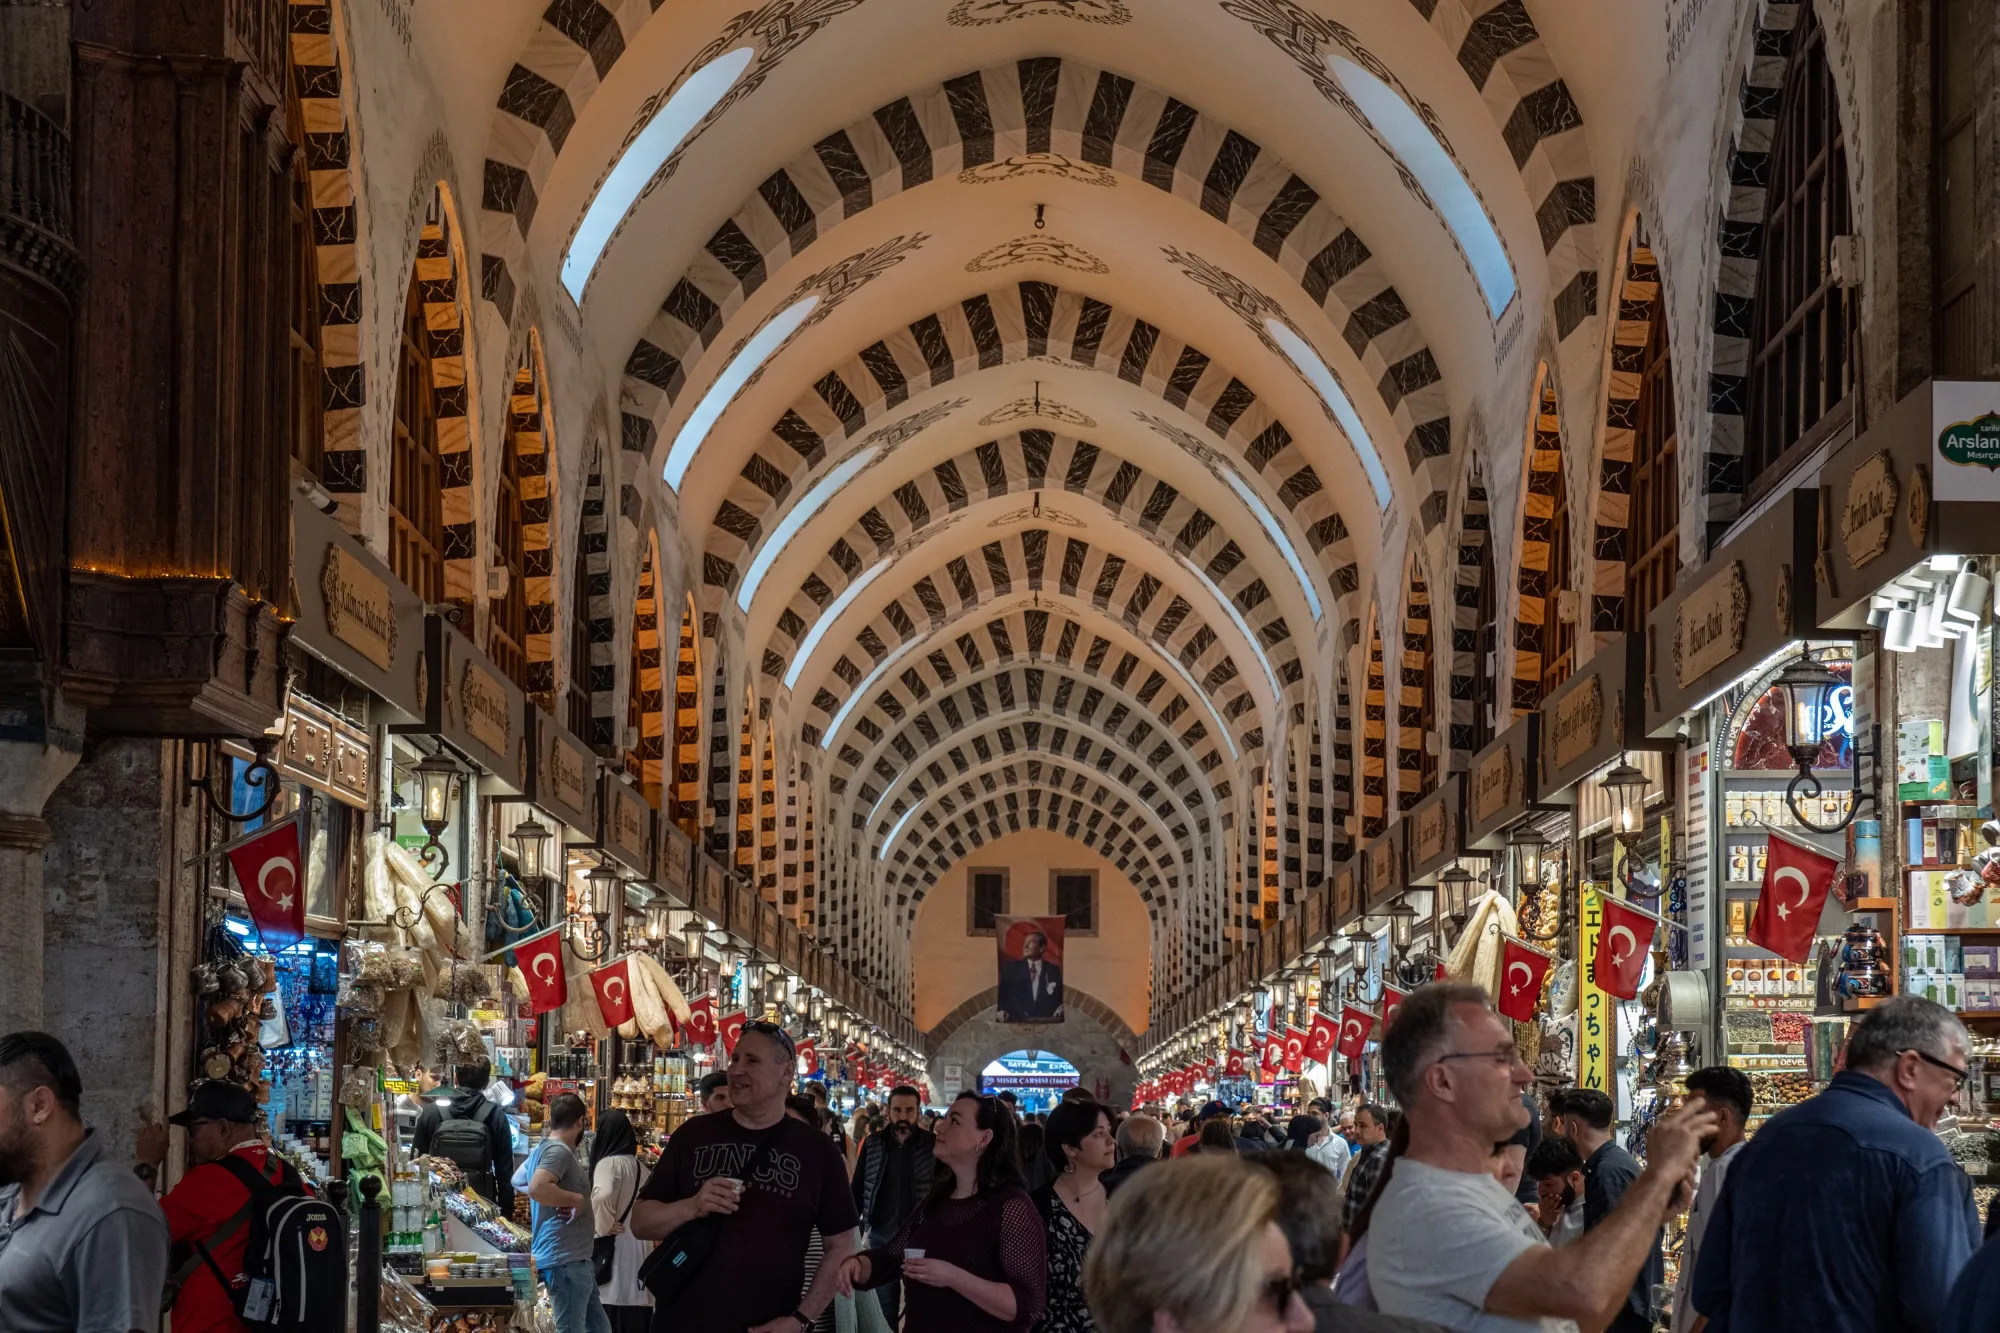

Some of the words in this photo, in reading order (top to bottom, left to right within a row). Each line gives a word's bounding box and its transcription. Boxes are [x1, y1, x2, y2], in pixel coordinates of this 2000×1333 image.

[1946, 434, 1999, 448] Arslan
[1008, 1061, 1038, 1069] BAYRAM
[545, 1082, 561, 1090] TEA
[759, 1184, 793, 1198] BRAND
